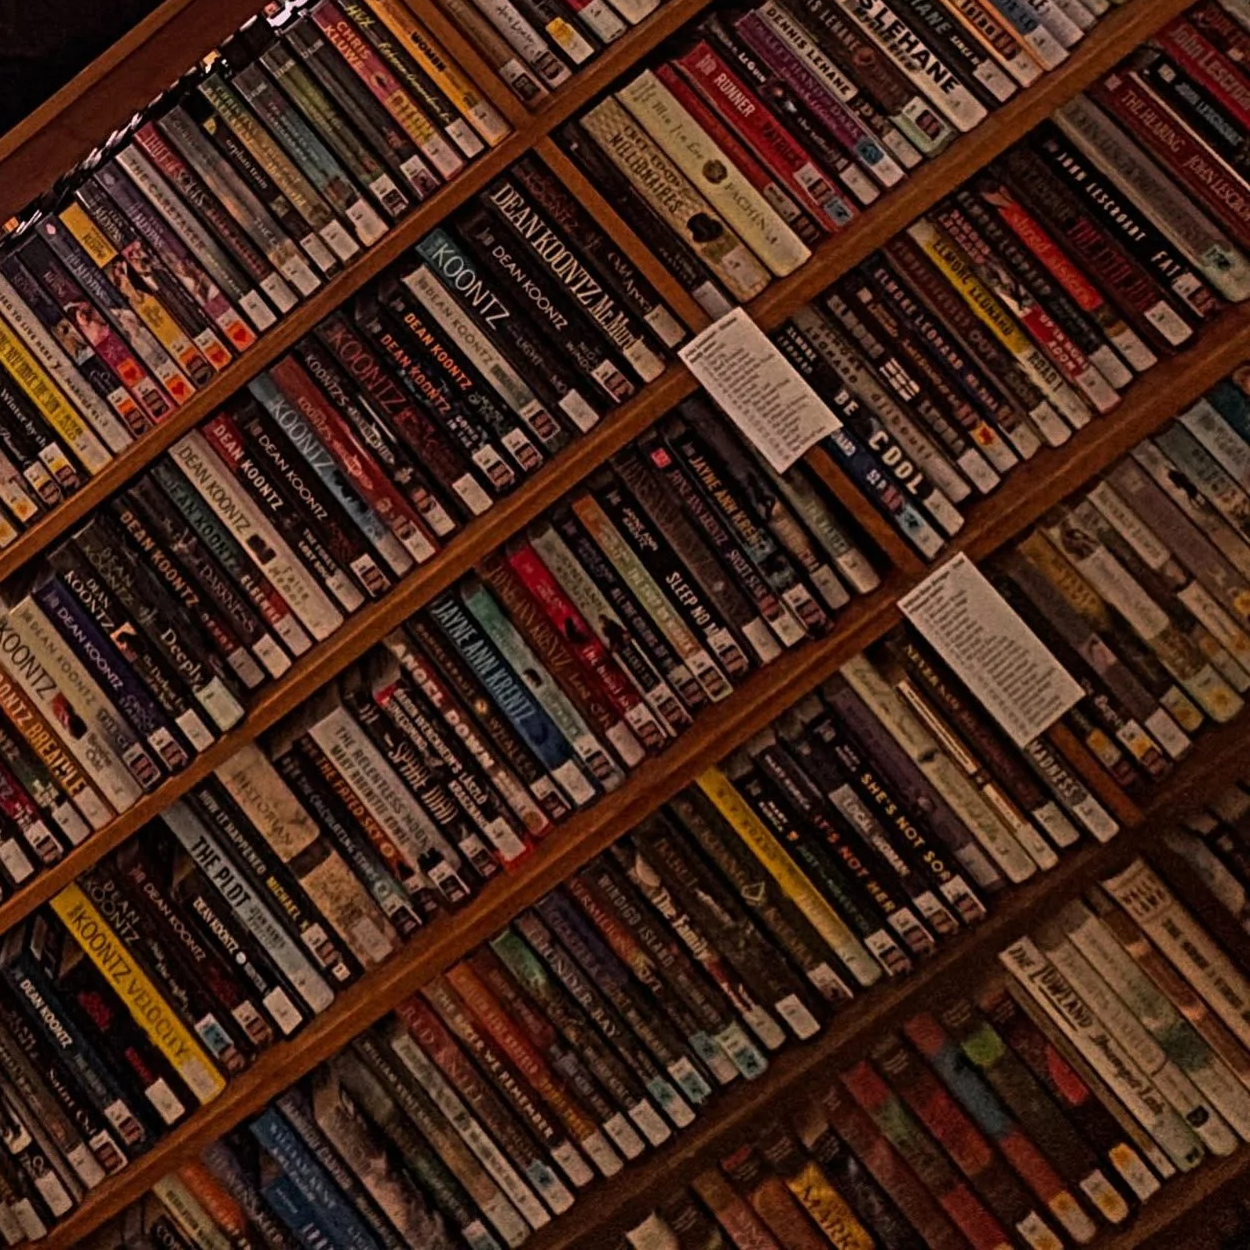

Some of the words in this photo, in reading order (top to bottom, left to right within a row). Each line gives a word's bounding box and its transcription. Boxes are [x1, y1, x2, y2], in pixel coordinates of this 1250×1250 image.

[322, 24, 364, 71] KLUWE
[334, 19, 372, 61] CHRIS
[409, 30, 447, 73] WOMEN
[766, 5, 808, 50] DENNIS
[805, 48, 851, 95] LEHANE
[817, 8, 862, 52] LEHANE
[873, 6, 960, 96] LEHANE
[712, 72, 756, 117] RUNNER
[221, 136, 253, 171] orphan
[247, 165, 270, 190] train
[606, 132, 684, 213] MILLIONAIRES
[1121, 90, 1146, 114] THE
[1139, 108, 1186, 152] HEARING
[1184, 153, 1218, 186] JOHN
[126, 158, 149, 183] THE
[146, 181, 207, 252] CARETAKER
[489, 179, 546, 239] DEAN
[530, 227, 604, 307] KOONTZ
[424, 285, 454, 317] DEAN
[450, 315, 495, 364] KOONTZ
[430, 240, 512, 330] KOONTZ
[490, 244, 527, 283] DEAN
[520, 278, 570, 332] KOONTZ
[872, 267, 917, 315] ELMORE
[913, 313, 966, 371] LEONARD
[10, 310, 23, 323] TO
[19, 321, 37, 341] LIVE
[34, 340, 53, 361] HERE
[378, 332, 412, 368] DEAN
[406, 364, 453, 416] KOONTZ
[402, 311, 435, 346] DEAN
[429, 342, 474, 391] KOONTZ
[22, 421, 38, 438] by
[211, 423, 245, 461] DEAN
[238, 458, 285, 511] KOONTZ
[832, 388, 860, 417] BE
[865, 428, 930, 495] COOL
[176, 445, 212, 485] DEAN
[204, 479, 251, 534] KOONTZ
[256, 433, 291, 473] DEAN
[284, 469, 329, 521] KOONTZ
[687, 451, 721, 491] JAYNE
[712, 485, 738, 514] ANN
[62, 569, 115, 632] KOONTZ
[118, 509, 155, 552] DEAN
[150, 549, 201, 608] KOONTZ
[664, 568, 699, 609] SLEEP
[689, 603, 712, 627] NO
[55, 606, 88, 643] DEAN
[82, 640, 125, 690] KOONTZ
[433, 595, 478, 647] JAYNE
[462, 635, 501, 677] ANN
[484, 665, 538, 727] KRENTZ
[903, 643, 941, 687] NEVER
[388, 640, 447, 708] ANGEL
[442, 708, 496, 771] DOWN
[314, 755, 338, 782] THE
[331, 778, 366, 819] FATED
[358, 815, 383, 843] SKY
[333, 725, 356, 750] THE
[350, 747, 406, 815] RELENTLESS
[1023, 738, 1080, 797] MADNESS
[840, 795, 875, 834] LOCAL
[870, 832, 911, 879] WOMAN
[858, 771, 899, 818] SHE'S
[893, 815, 926, 850] NOT
[188, 835, 221, 872] THE
[211, 865, 252, 910] PLOT
[197, 789, 221, 815] HOW
[215, 811, 229, 827] IT
[223, 821, 267, 876] HAPPENED
[264, 875, 302, 922] MICHAEL
[811, 812, 841, 845] IT'S
[836, 843, 869, 879] NOT
[865, 879, 897, 914] HER
[142, 881, 173, 917] DEAN
[166, 913, 208, 963] KOONTZ
[596, 873, 643, 928] WINDIGO
[636, 922, 677, 969] ISLAND
[652, 888, 682, 922] The
[669, 912, 715, 965] Family
[18, 977, 44, 1008] DEAN
[37, 1004, 74, 1049] KOONTZ
[70, 909, 133, 984] KOONTZ
[122, 977, 192, 1062] VELOCITY
[589, 1005, 620, 1040] BAY
[497, 1070, 555, 1139] REMEMBER
